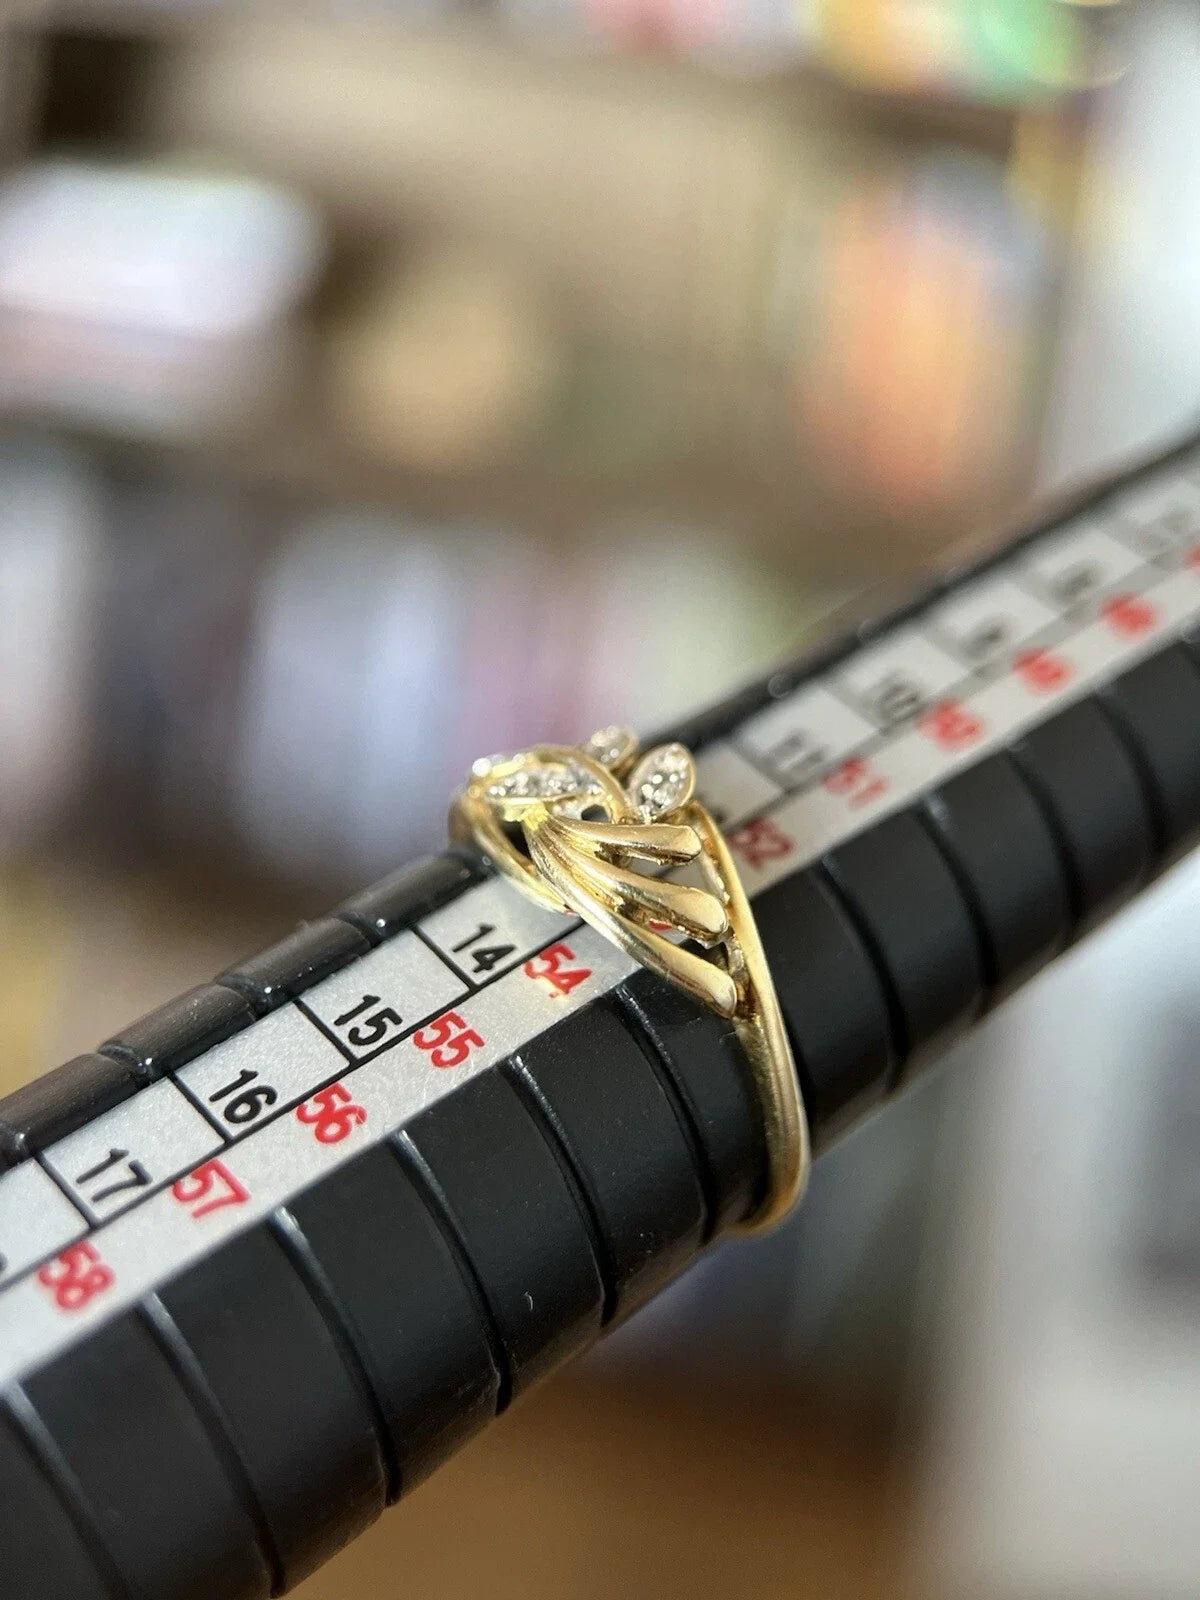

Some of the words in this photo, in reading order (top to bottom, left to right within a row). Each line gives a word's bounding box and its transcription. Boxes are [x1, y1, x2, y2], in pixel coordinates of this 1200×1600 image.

[726, 816, 796, 870] 52
[452, 922, 517, 974] 14
[523, 942, 593, 998] 54
[333, 994, 404, 1047] 15
[412, 1010, 486, 1069] 55
[208, 1068, 279, 1124] 16
[295, 1082, 368, 1145] 56
[75, 1147, 154, 1204] 17
[171, 1158, 251, 1219] 57
[37, 1240, 116, 1311] 58
